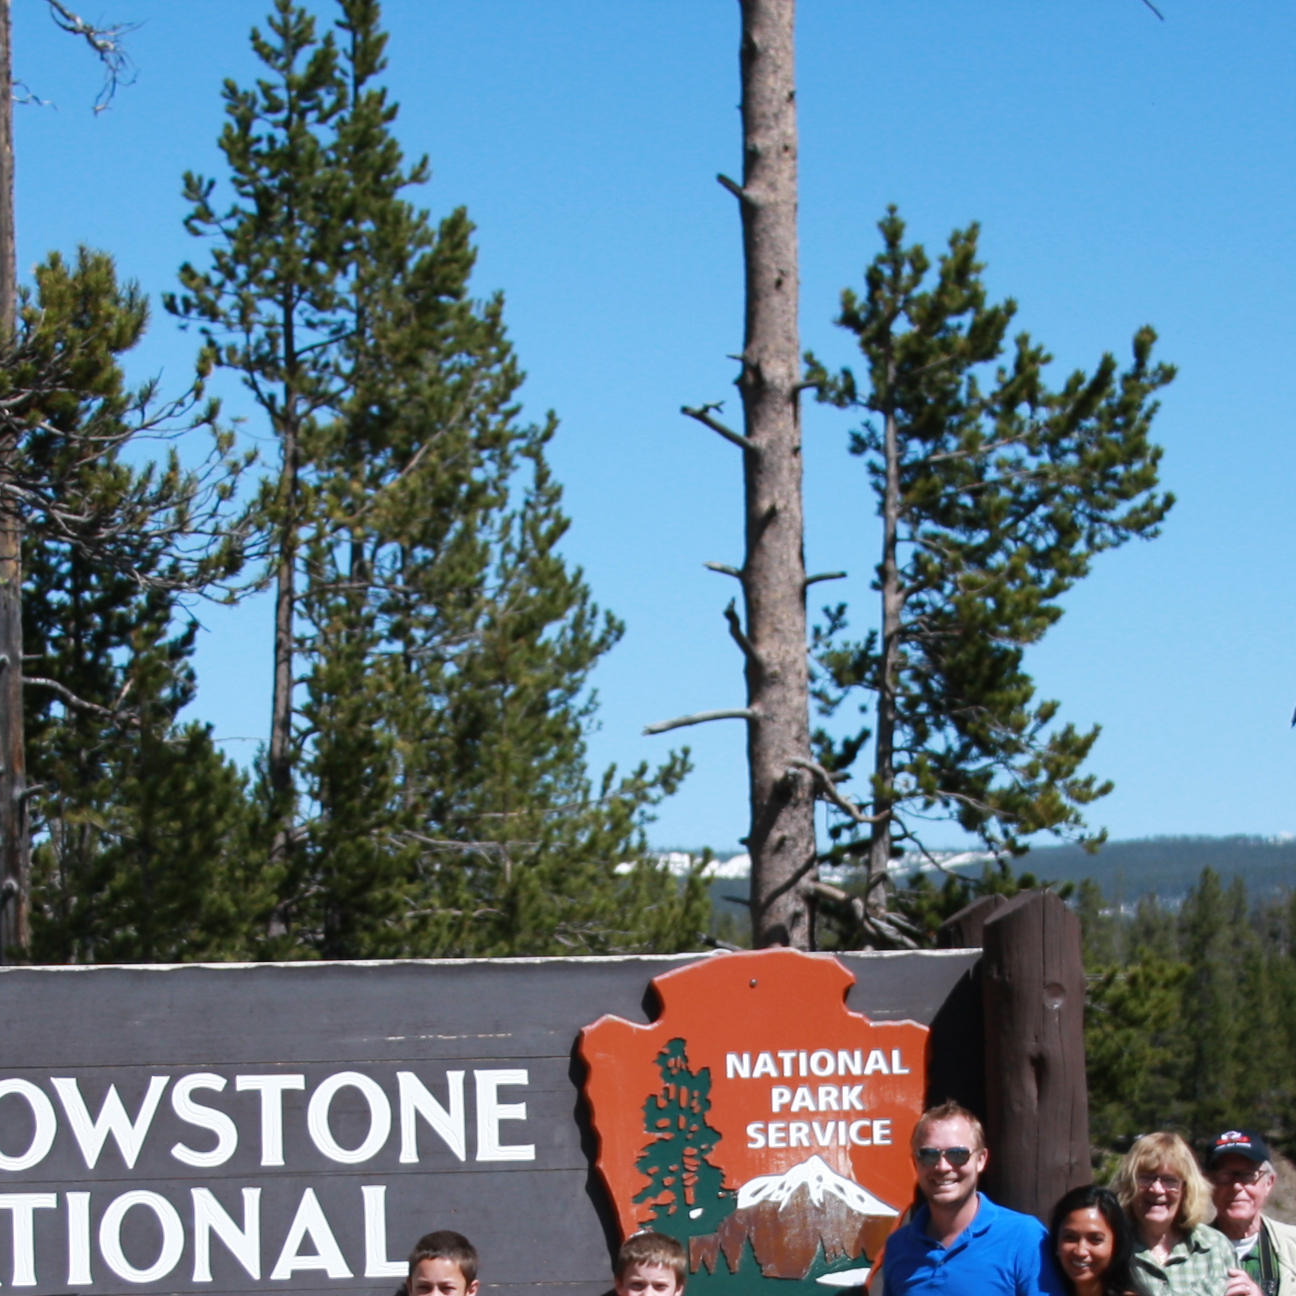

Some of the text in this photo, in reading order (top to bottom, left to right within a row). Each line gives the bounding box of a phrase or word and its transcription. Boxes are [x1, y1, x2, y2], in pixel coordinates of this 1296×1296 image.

[725, 1048, 910, 1079] NATIONAL
[770, 1083, 865, 1112] PARK
[746, 1118, 893, 1149] SERVICE
